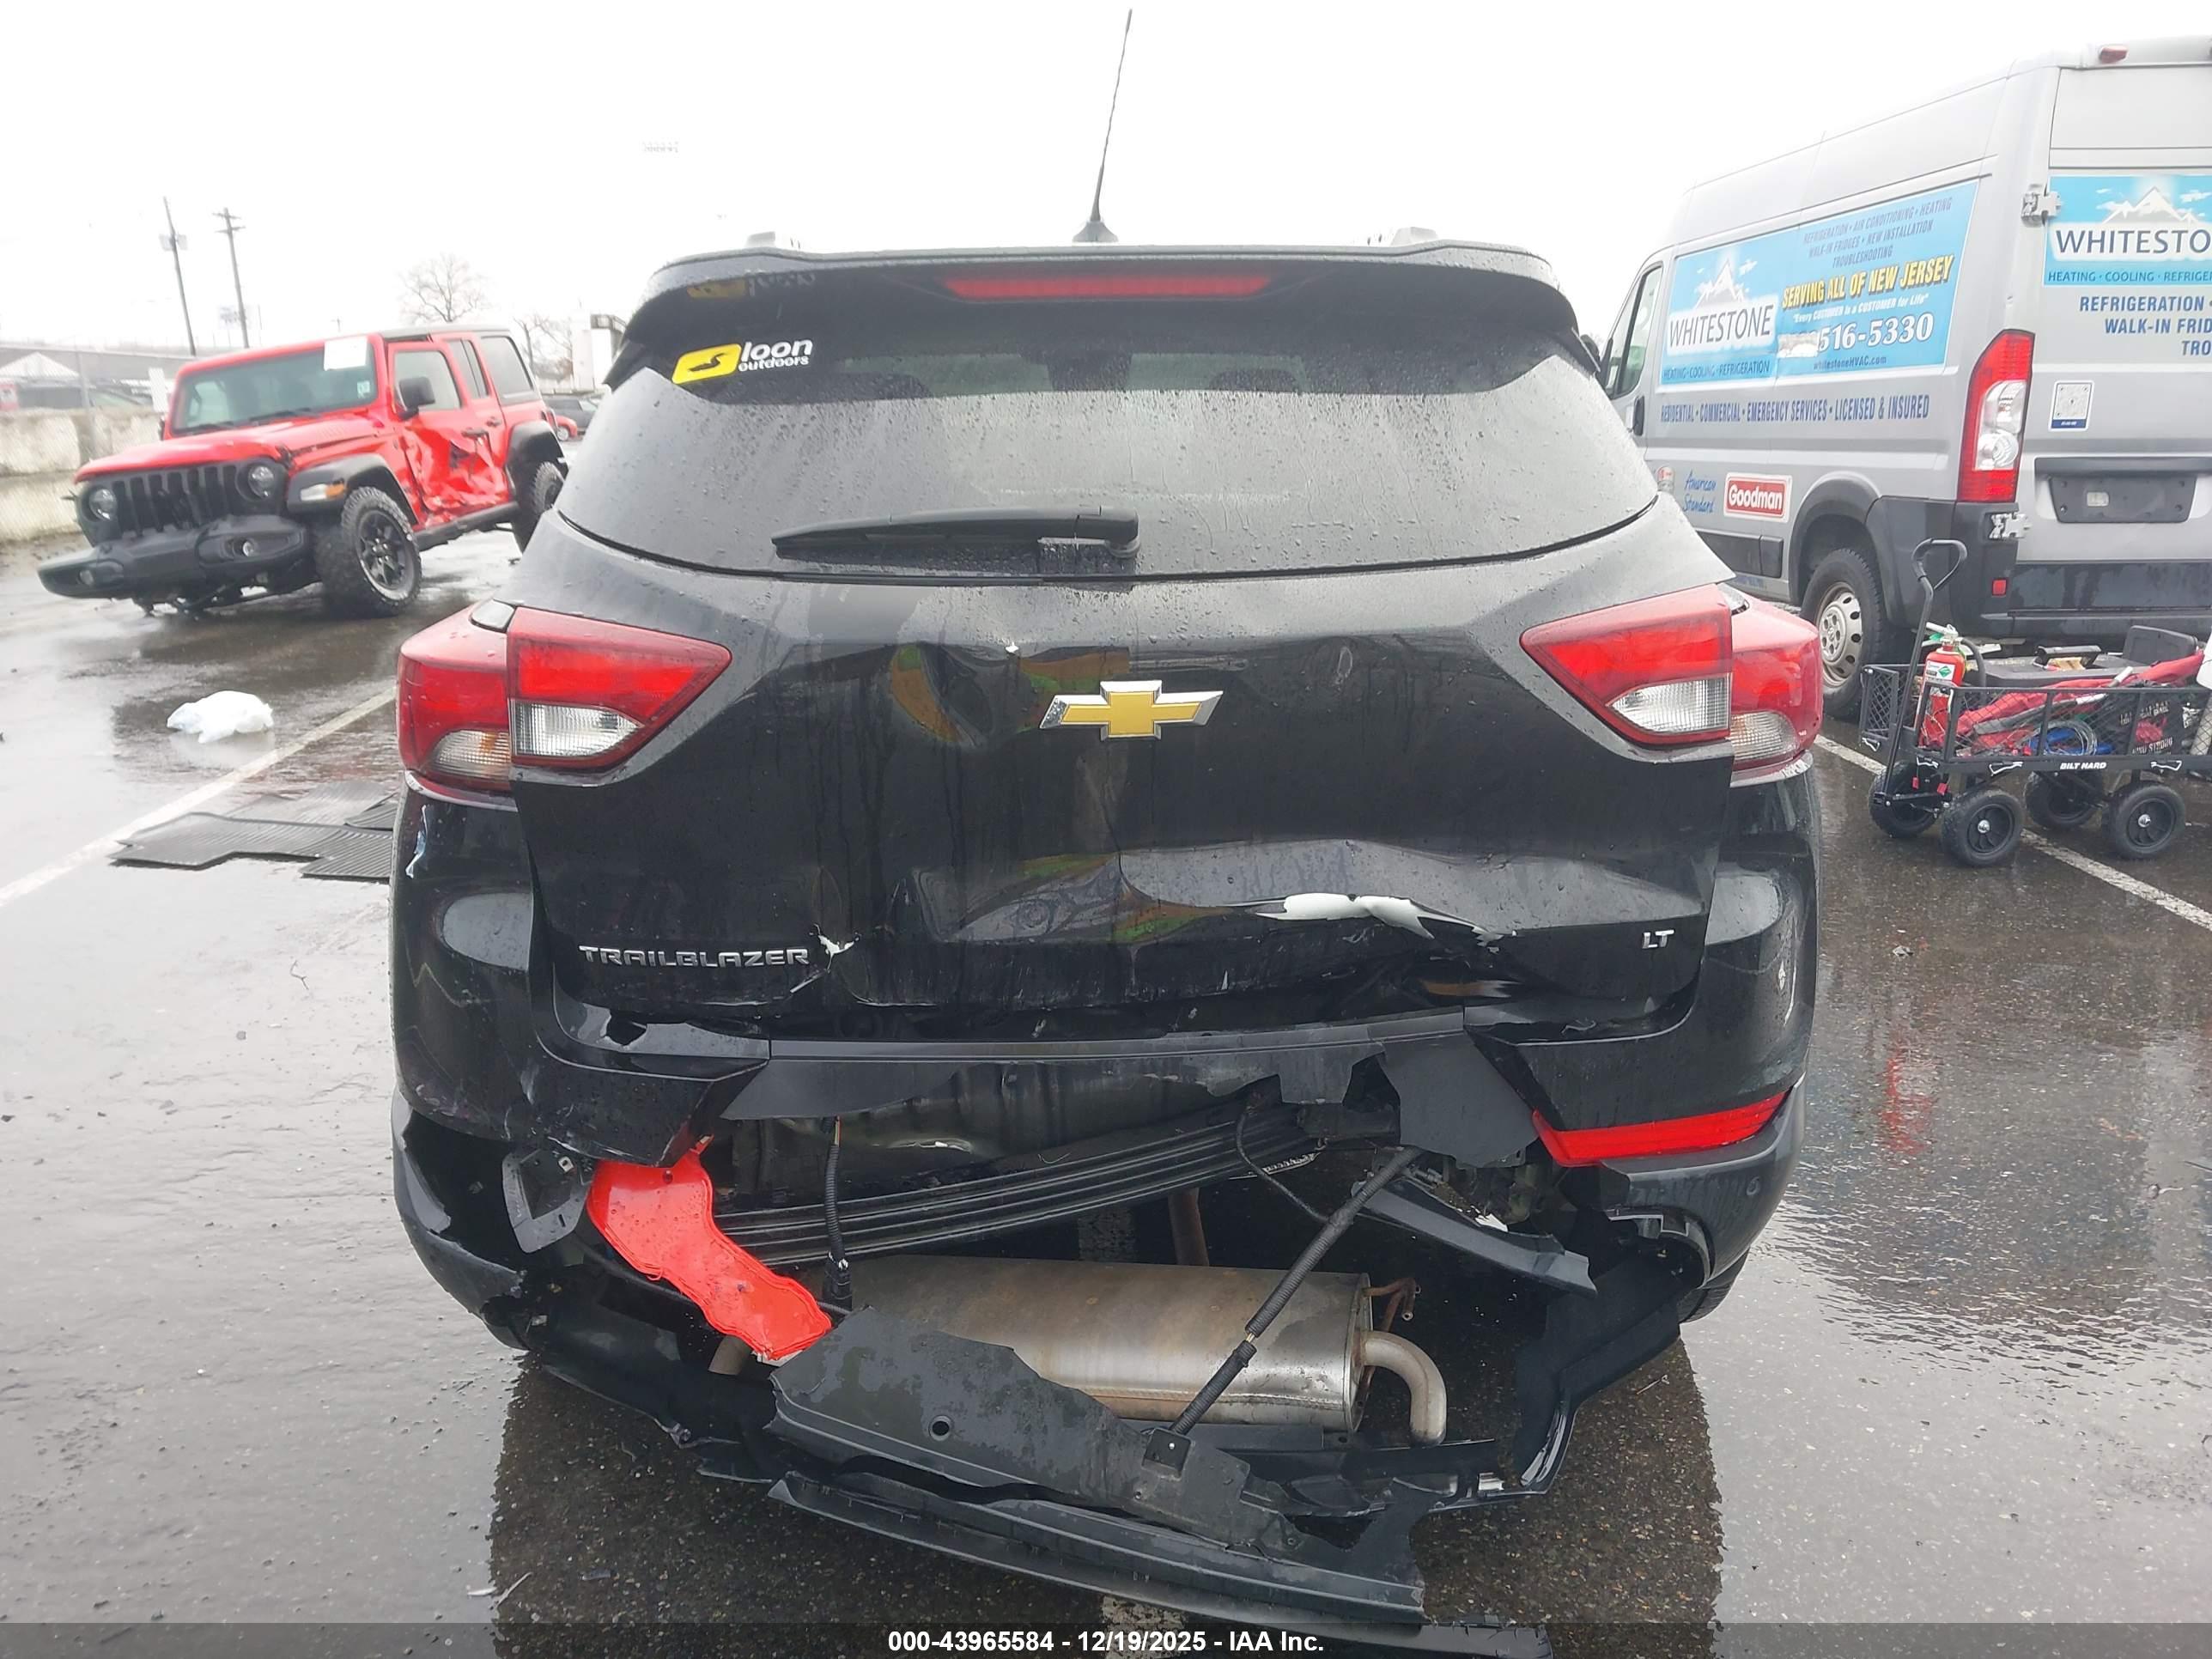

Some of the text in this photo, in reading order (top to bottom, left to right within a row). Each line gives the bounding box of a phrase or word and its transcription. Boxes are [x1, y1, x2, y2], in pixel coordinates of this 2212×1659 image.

[1852, 219, 1864, 232] AIR
[1865, 206, 1915, 230] CONDITIONING
[1919, 197, 1954, 216] HEATING
[1833, 234, 1862, 252] FRIDGES
[1867, 230, 1882, 245] NEW
[1883, 219, 1935, 241] INSTALLATION
[2055, 228, 2212, 254] WHITESTO
[1832, 245, 1893, 268] TROUBLESHOOTING
[1782, 254, 1954, 310] SERVING ALL OF NEW JERSEY
[2048, 270, 2096, 283] HEATING
[2105, 270, 2154, 283] COOLING
[1858, 299, 1897, 313] CUSTOMER
[1898, 296, 1909, 307] for
[2079, 295, 2205, 312] REFRIGERATION
[1669, 304, 1774, 348] WHITESTONE
[2104, 318, 2172, 335] WALK-IN
[740, 339, 813, 362] loon
[2181, 339, 2212, 356] TRO
[738, 355, 810, 373] outdoors
[1663, 360, 1771, 380] HEATING COOLING REFRIGERATION
[1661, 394, 1930, 423] RESIDENTIAL COMMERCIAL EMERGENCY SERVICES LICENSED & INSURED
[1728, 484, 1784, 511] Goodman
[2081, 762, 2107, 770] HARD
[1642, 929, 1675, 949] LT
[578, 945, 811, 968] TRAILBLAZER
